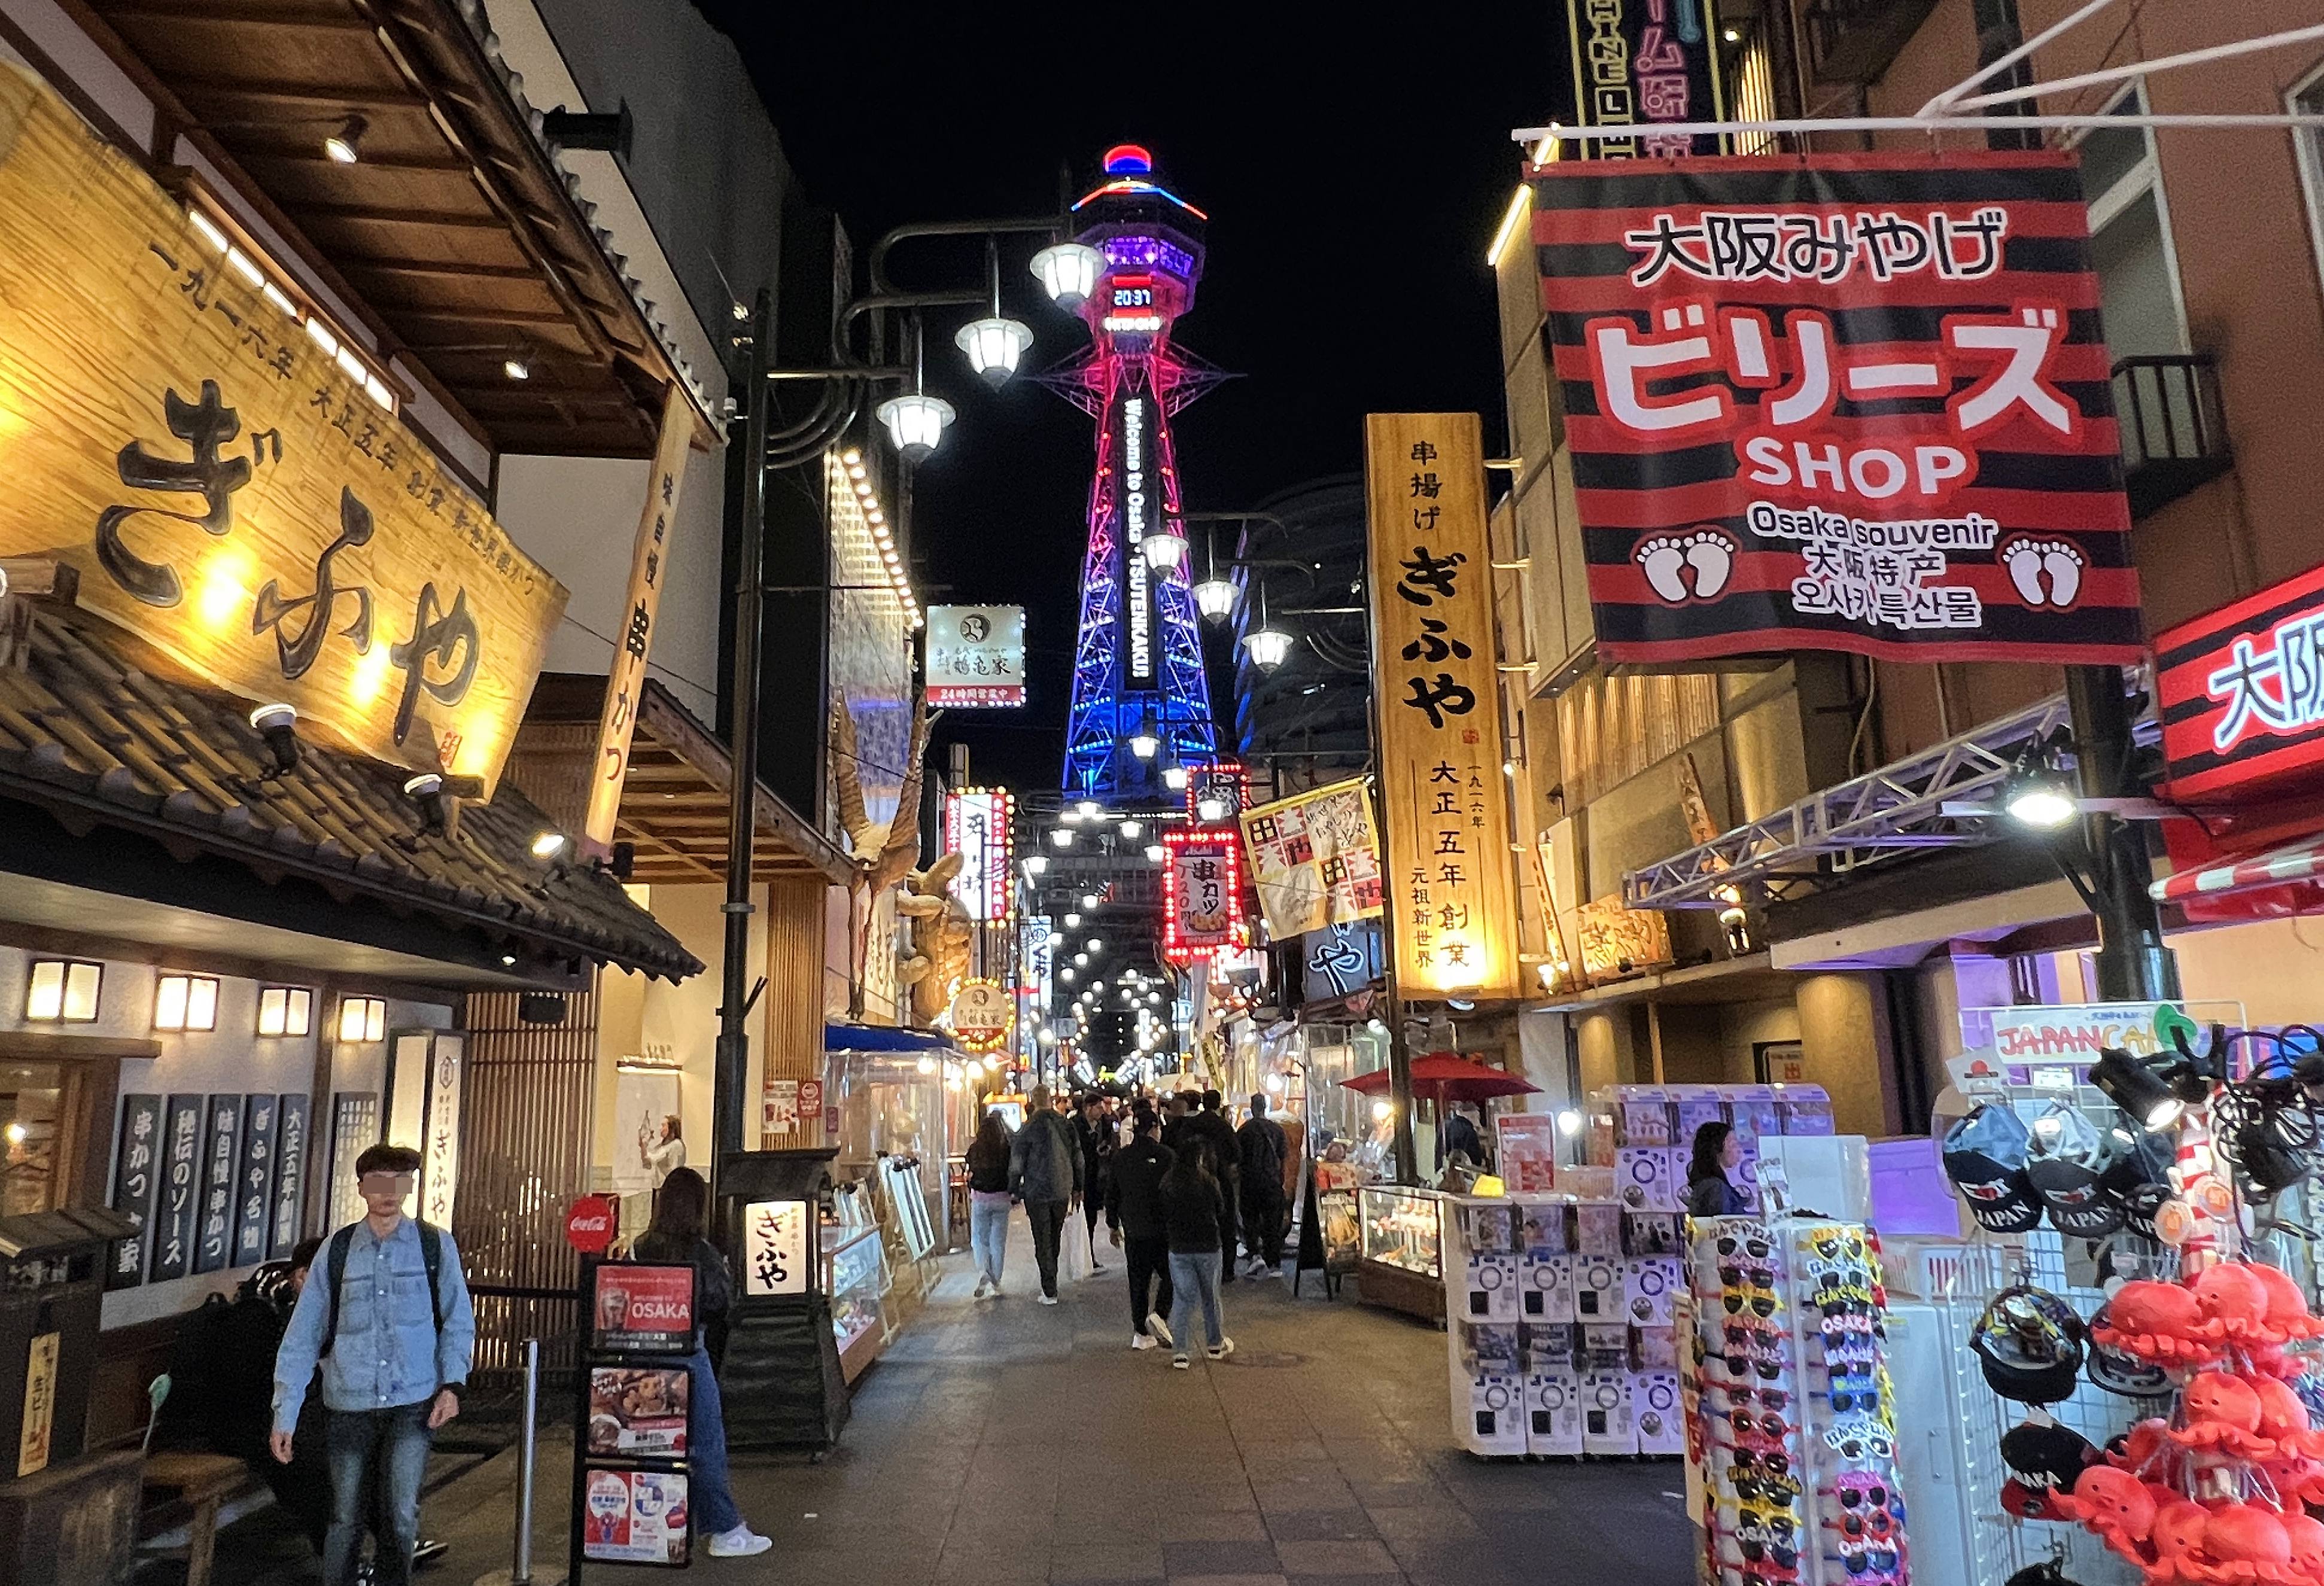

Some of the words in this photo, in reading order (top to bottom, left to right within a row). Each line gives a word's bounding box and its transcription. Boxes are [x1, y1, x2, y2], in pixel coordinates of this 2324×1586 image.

[1626, 209, 2006, 286] 大阪みやげ
[150, 241, 294, 382] 一九一六年
[309, 386, 398, 471] 大正五年
[1596, 304, 2071, 436] ビリーズ
[1124, 398, 1142, 471] Welcome
[1746, 436, 1967, 498] SHOP
[1127, 472, 1143, 491] to
[1410, 440, 1443, 532] 串揚げ
[1128, 492, 1145, 544] Osaka
[1751, 506, 1849, 540] Osaka
[1854, 515, 1997, 548] souvenir
[96, 378, 480, 747] ぎふや
[1806, 546, 1946, 588] 大阪特产
[1792, 579, 1982, 629] 오사카특산물
[1396, 545, 1476, 730] ぎふや
[1467, 764, 1485, 829] 一九一六年
[1191, 859, 1219, 916] 串カツ
[1429, 760, 1470, 967] 大正五年創業
[1410, 866, 1434, 969] 元祖新世界
[1997, 1025, 2104, 1055] JAPAN
[164, 1109, 196, 1265] 秘伝のソース
[1976, 1200, 2033, 1228] JAPAN
[2055, 1203, 2113, 1228] JAPAN
[755, 1209, 788, 1289] ぎふや
[631, 1302, 690, 1320] OSAKA
